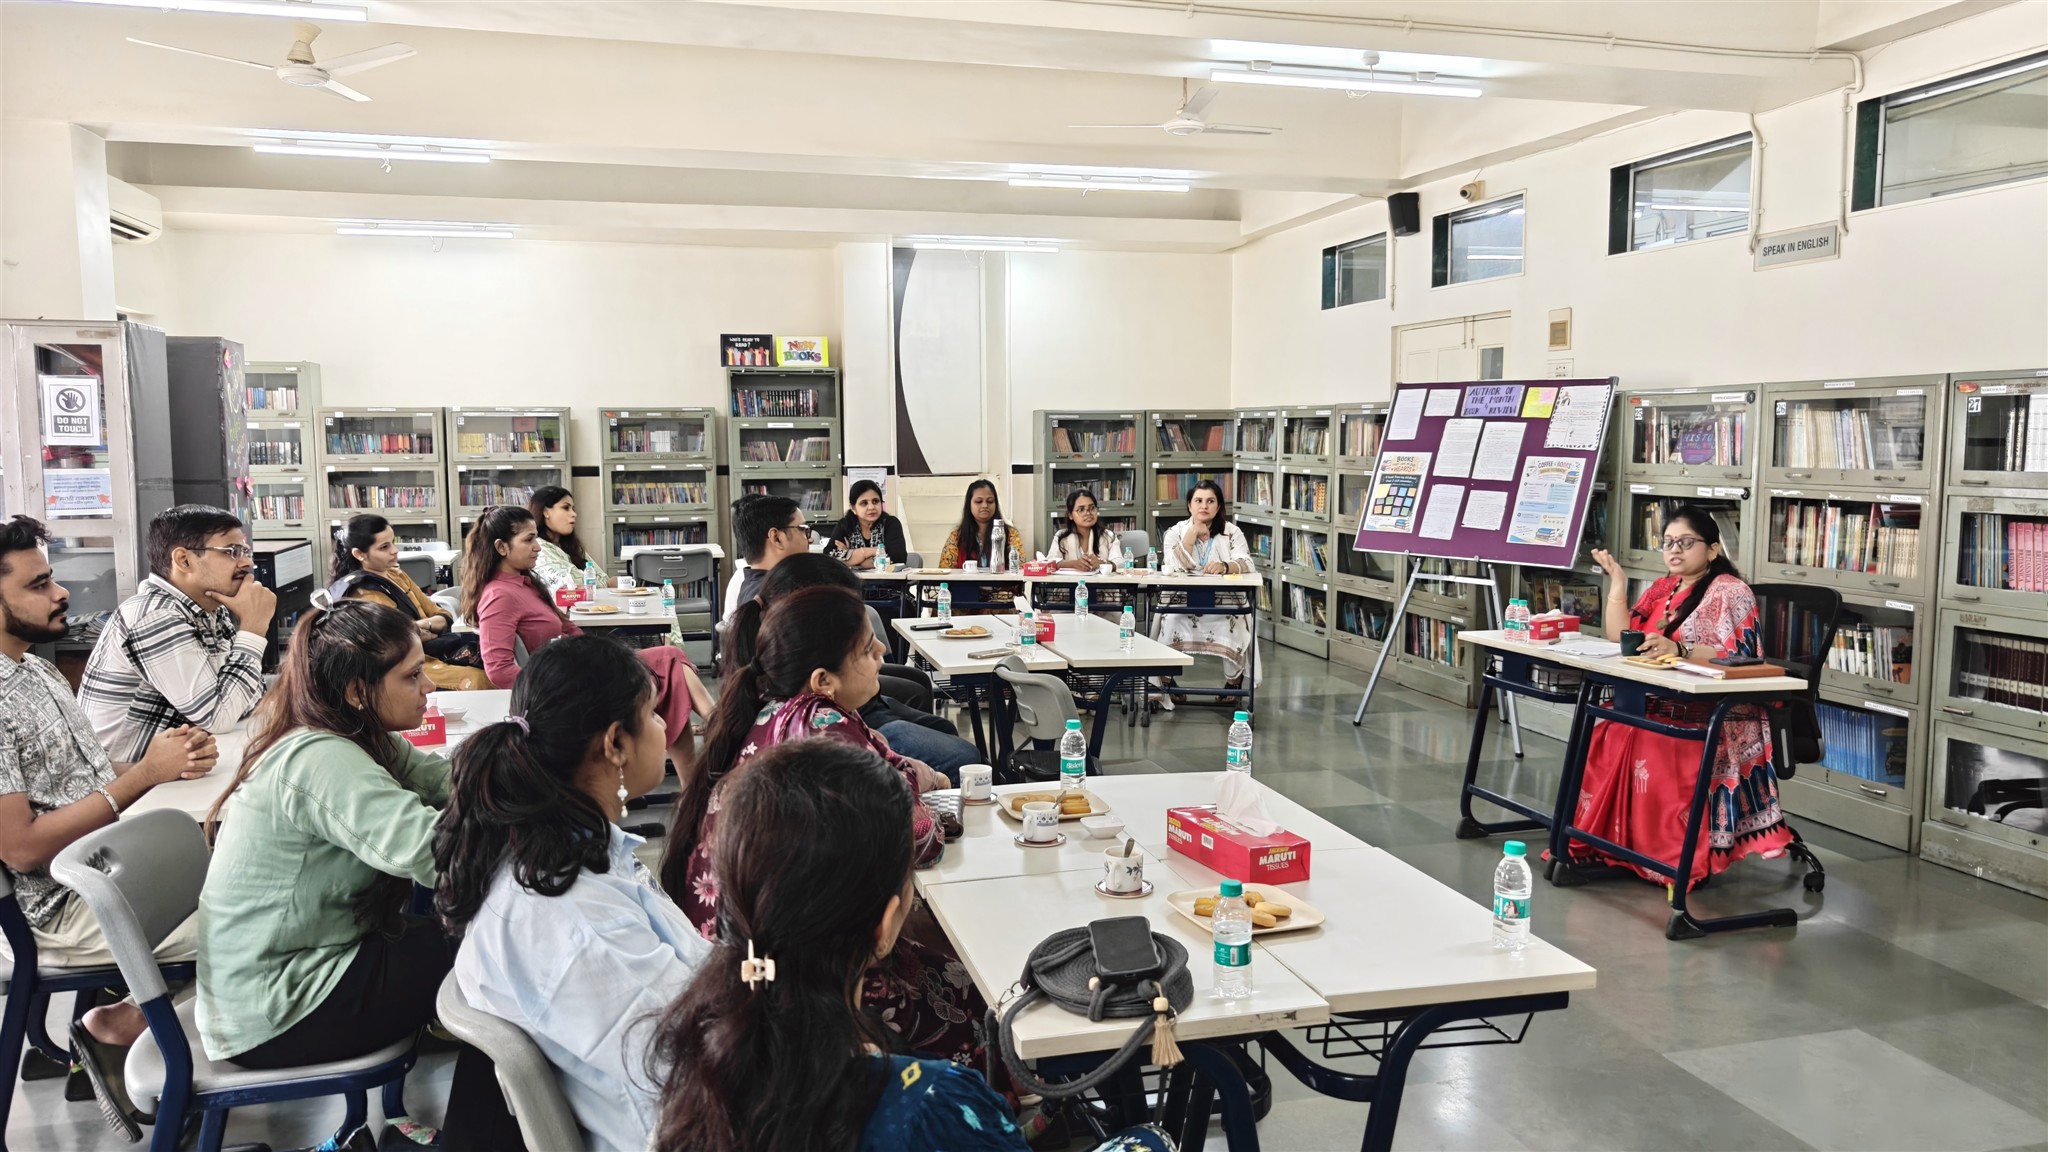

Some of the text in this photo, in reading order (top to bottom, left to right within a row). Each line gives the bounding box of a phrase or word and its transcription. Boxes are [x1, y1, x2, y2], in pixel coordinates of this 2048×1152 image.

[1763, 236, 1829, 257] SPEAK IN ENGLISH
[787, 340, 816, 352] NEW
[783, 351, 822, 362] BOOKS
[1469, 386, 1515, 396] AUTHOR OF
[1471, 396, 1515, 404] THE MONTH
[1968, 398, 1980, 412] 27
[1464, 405, 1517, 416] BOOK REVIEW
[1635, 409, 1643, 419] 25
[1776, 403, 1786, 414] 26
[56, 416, 88, 425] DO NOT
[58, 425, 88, 433] TOUCH
[1538, 461, 1554, 469] COFFEE
[1168, 824, 1192, 843] MARUTI
[1259, 850, 1297, 866] MARUTI
[1266, 861, 1290, 871] TISSUES
